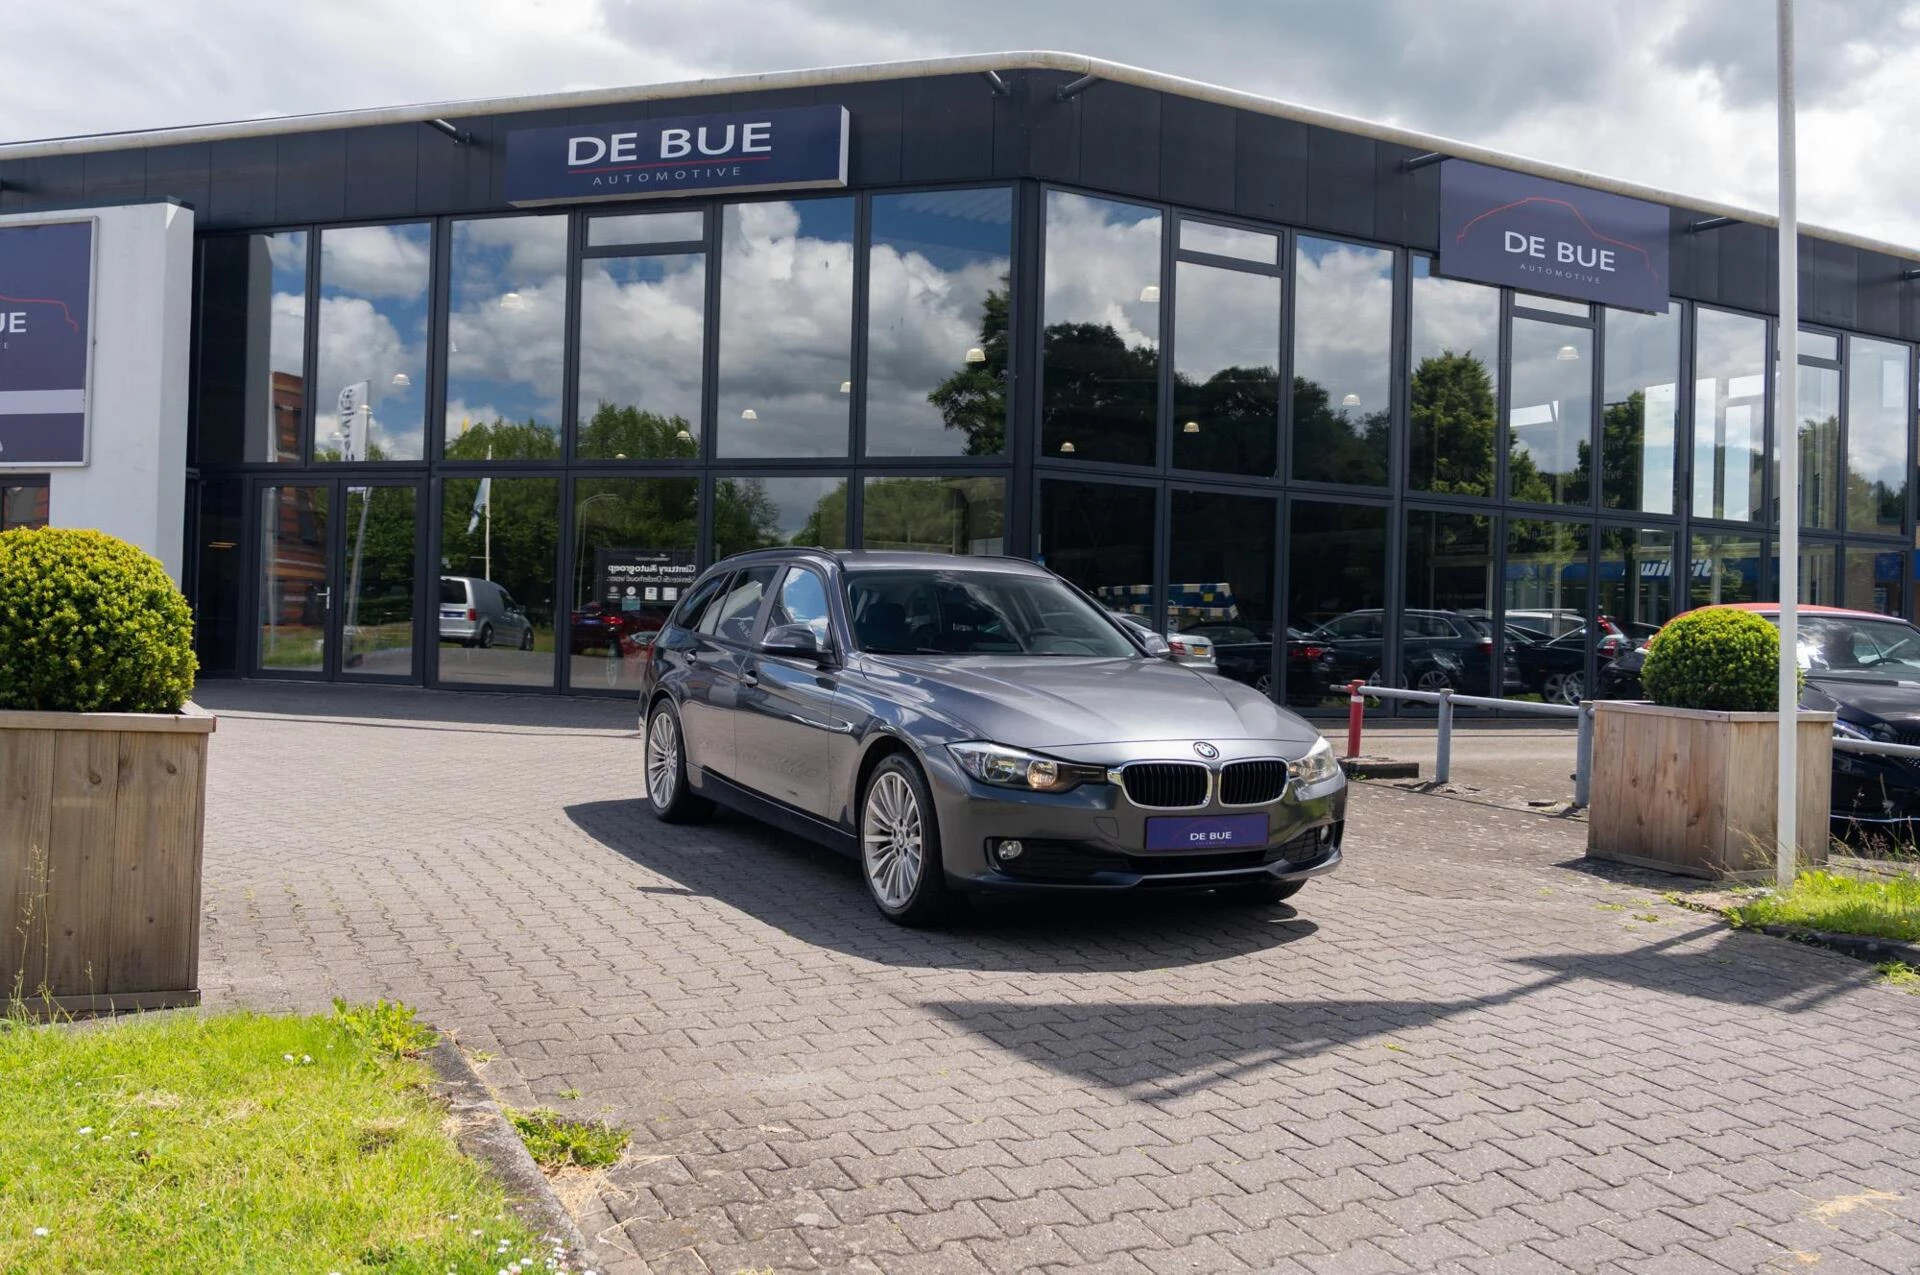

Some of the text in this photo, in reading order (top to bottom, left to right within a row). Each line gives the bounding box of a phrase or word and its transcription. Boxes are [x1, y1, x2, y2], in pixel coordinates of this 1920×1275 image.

[567, 121, 772, 166] DE BUE
[592, 166, 742, 186] AUTOMOTIVE
[1504, 230, 1616, 272] DE BUE
[1519, 263, 1601, 284] AUTOMOTIVE
[0, 312, 27, 334] E
[1190, 832, 1232, 841] DE BUE
